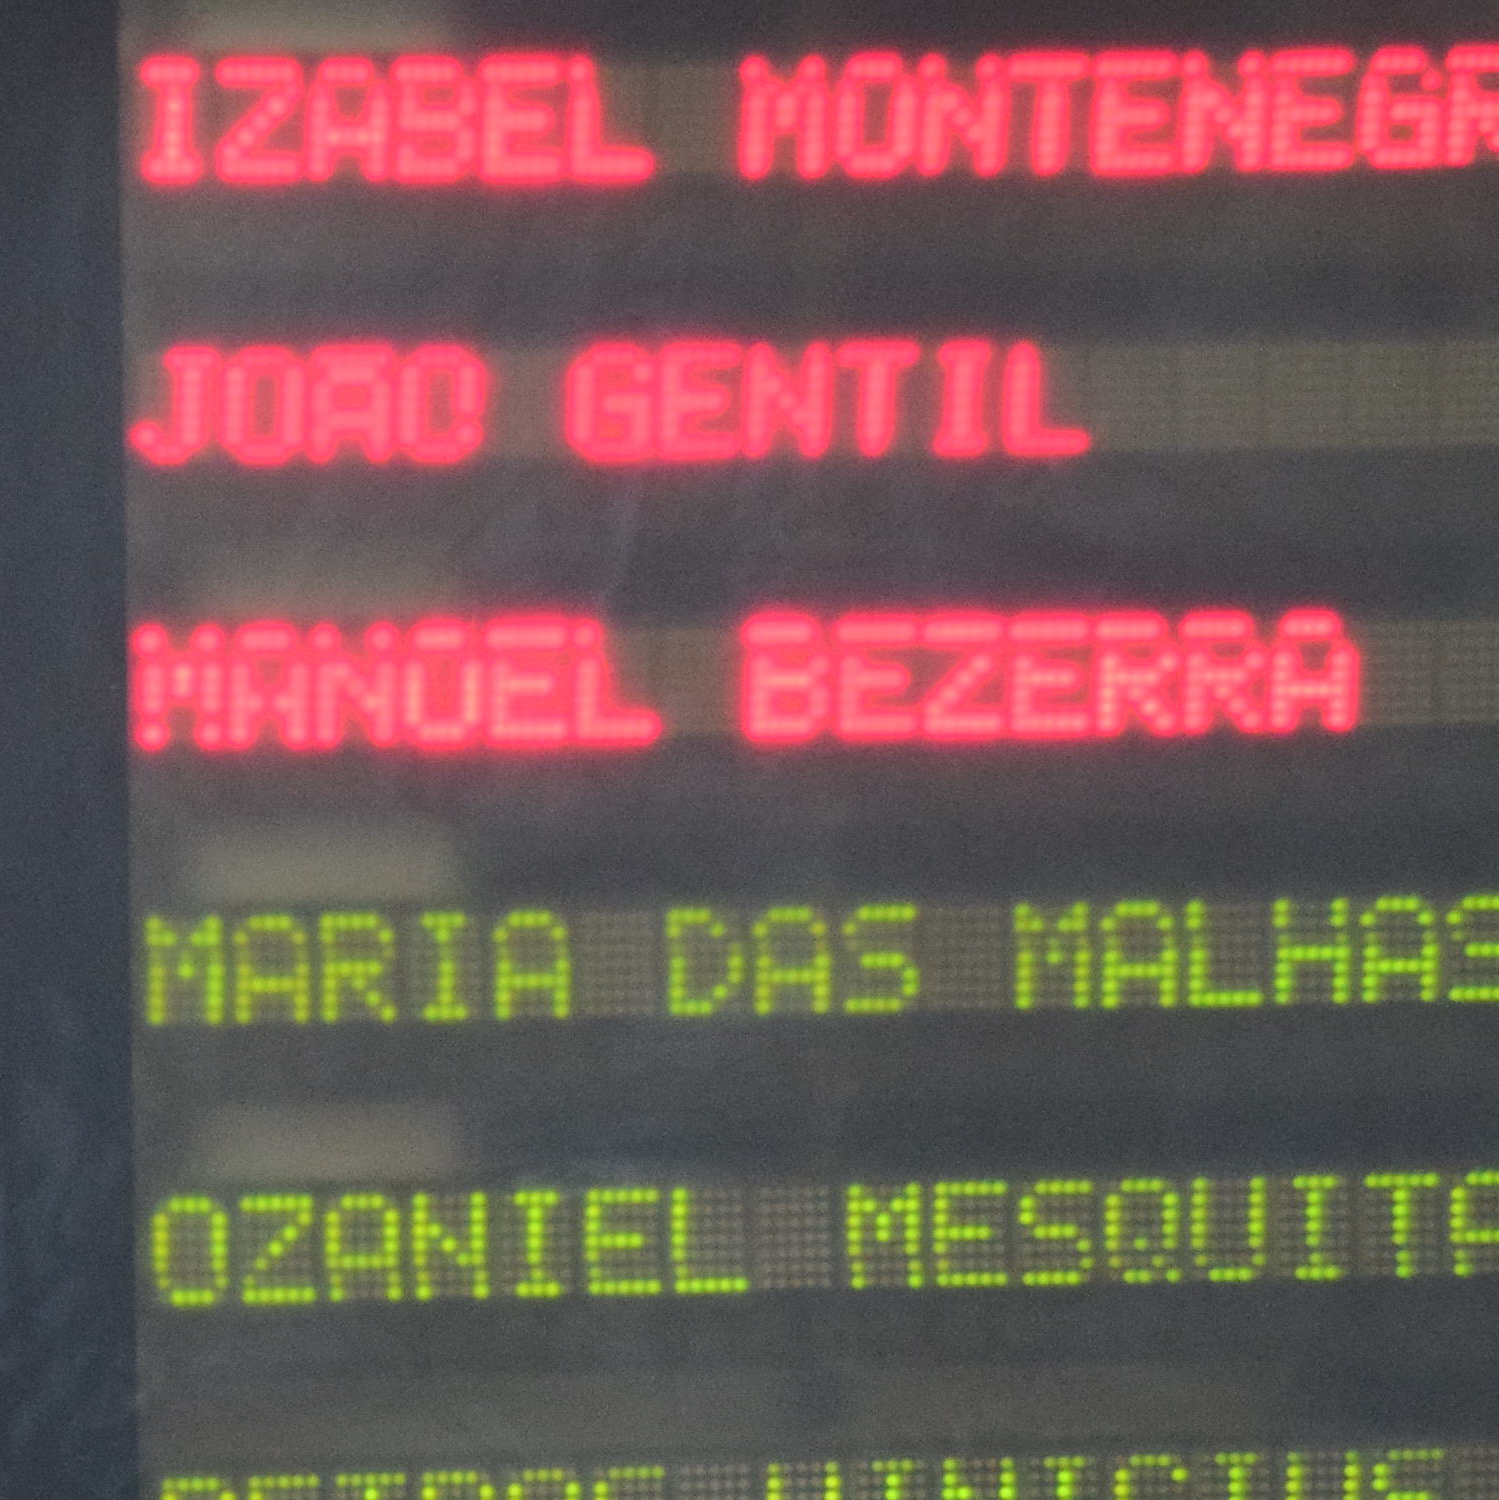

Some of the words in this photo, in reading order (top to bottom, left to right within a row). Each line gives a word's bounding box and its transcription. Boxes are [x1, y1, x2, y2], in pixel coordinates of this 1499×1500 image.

[139, 52, 655, 188] IZABEL
[562, 338, 1090, 465] GENTIL
[130, 611, 664, 754] MANOEL
[737, 608, 1361, 746] BEZERRA
[146, 912, 571, 1024] MARIA
[667, 904, 919, 1015] DAS
[1015, 895, 1499, 1008] MALHAS
[152, 1188, 748, 1307] OZANIEL
[847, 1171, 1499, 1288] MESQUITA
